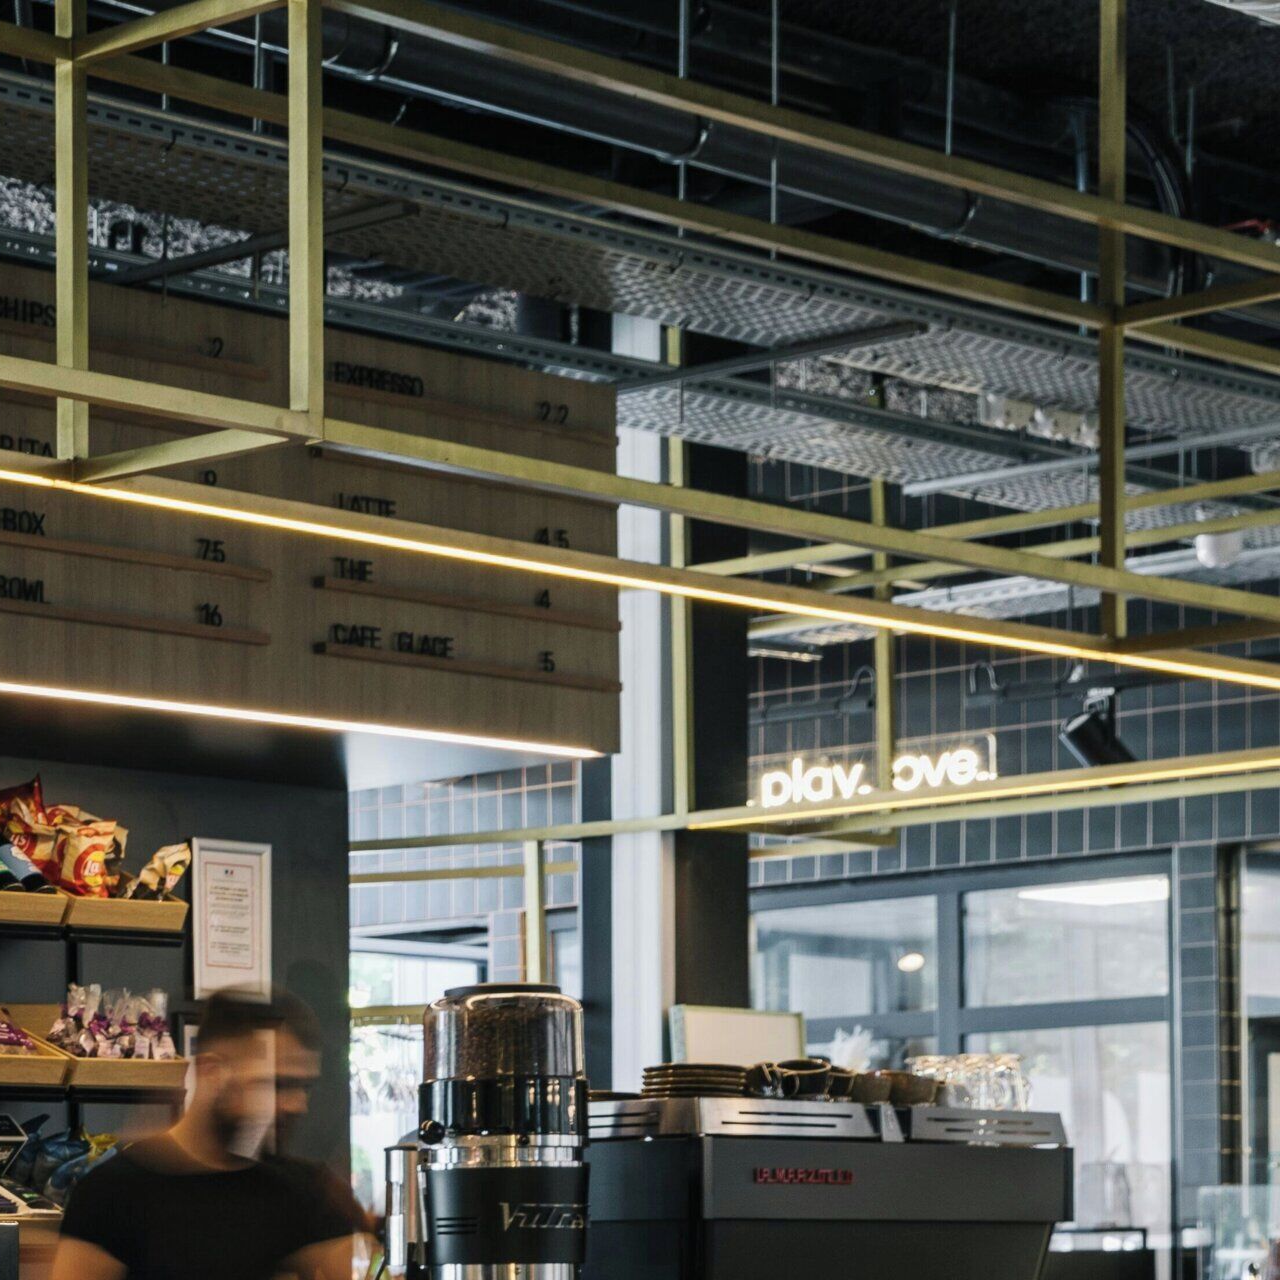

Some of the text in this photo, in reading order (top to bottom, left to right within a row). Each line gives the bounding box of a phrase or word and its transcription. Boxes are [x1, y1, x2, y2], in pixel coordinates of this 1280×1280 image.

[333, 362, 424, 398] EXPRESSO
[1, 508, 46, 536] BOX
[334, 557, 373, 581] THE
[198, 603, 223, 627] 16
[333, 624, 382, 648] CAFE
[539, 652, 555, 672] 5
[890, 749, 990, 793] ove.
